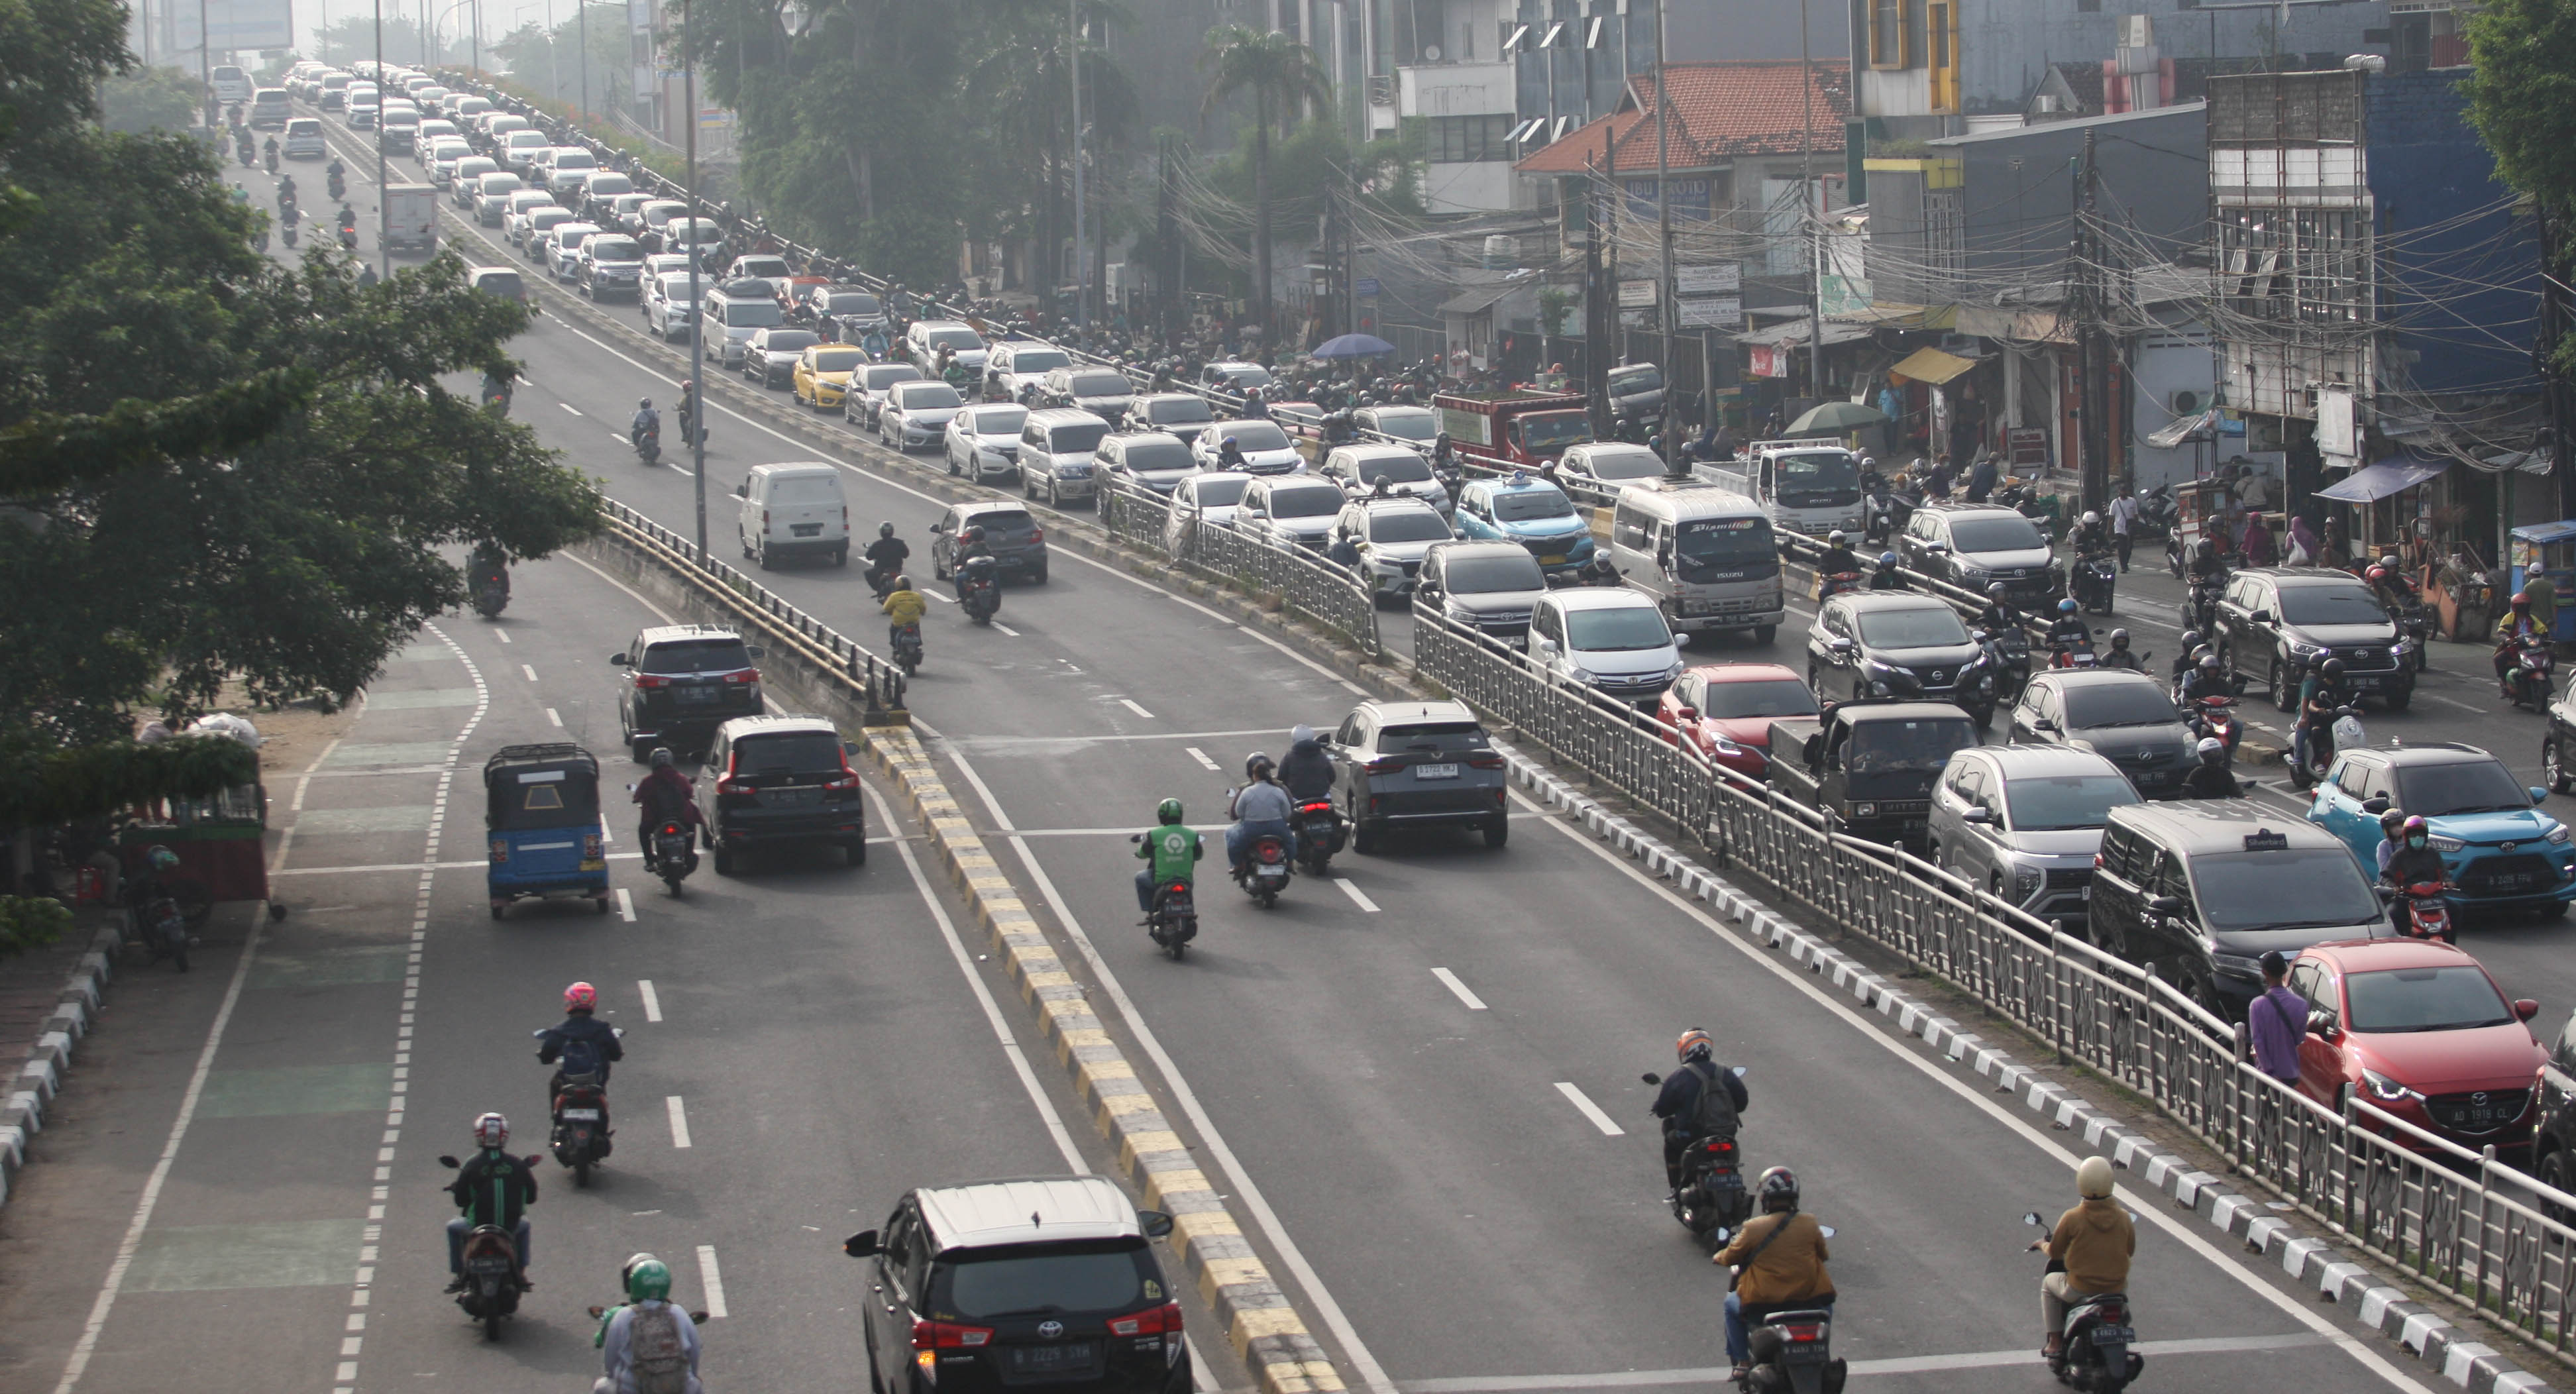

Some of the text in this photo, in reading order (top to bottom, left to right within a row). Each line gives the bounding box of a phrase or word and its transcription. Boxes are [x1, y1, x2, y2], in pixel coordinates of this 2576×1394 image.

[1630, 180, 1652, 196] IBU
[1884, 802, 1929, 811] MITSU
[2248, 837, 2285, 847] Silverbird
[2083, 887, 2089, 896] B
[2453, 1108, 2508, 1121] AD 1918 CL
